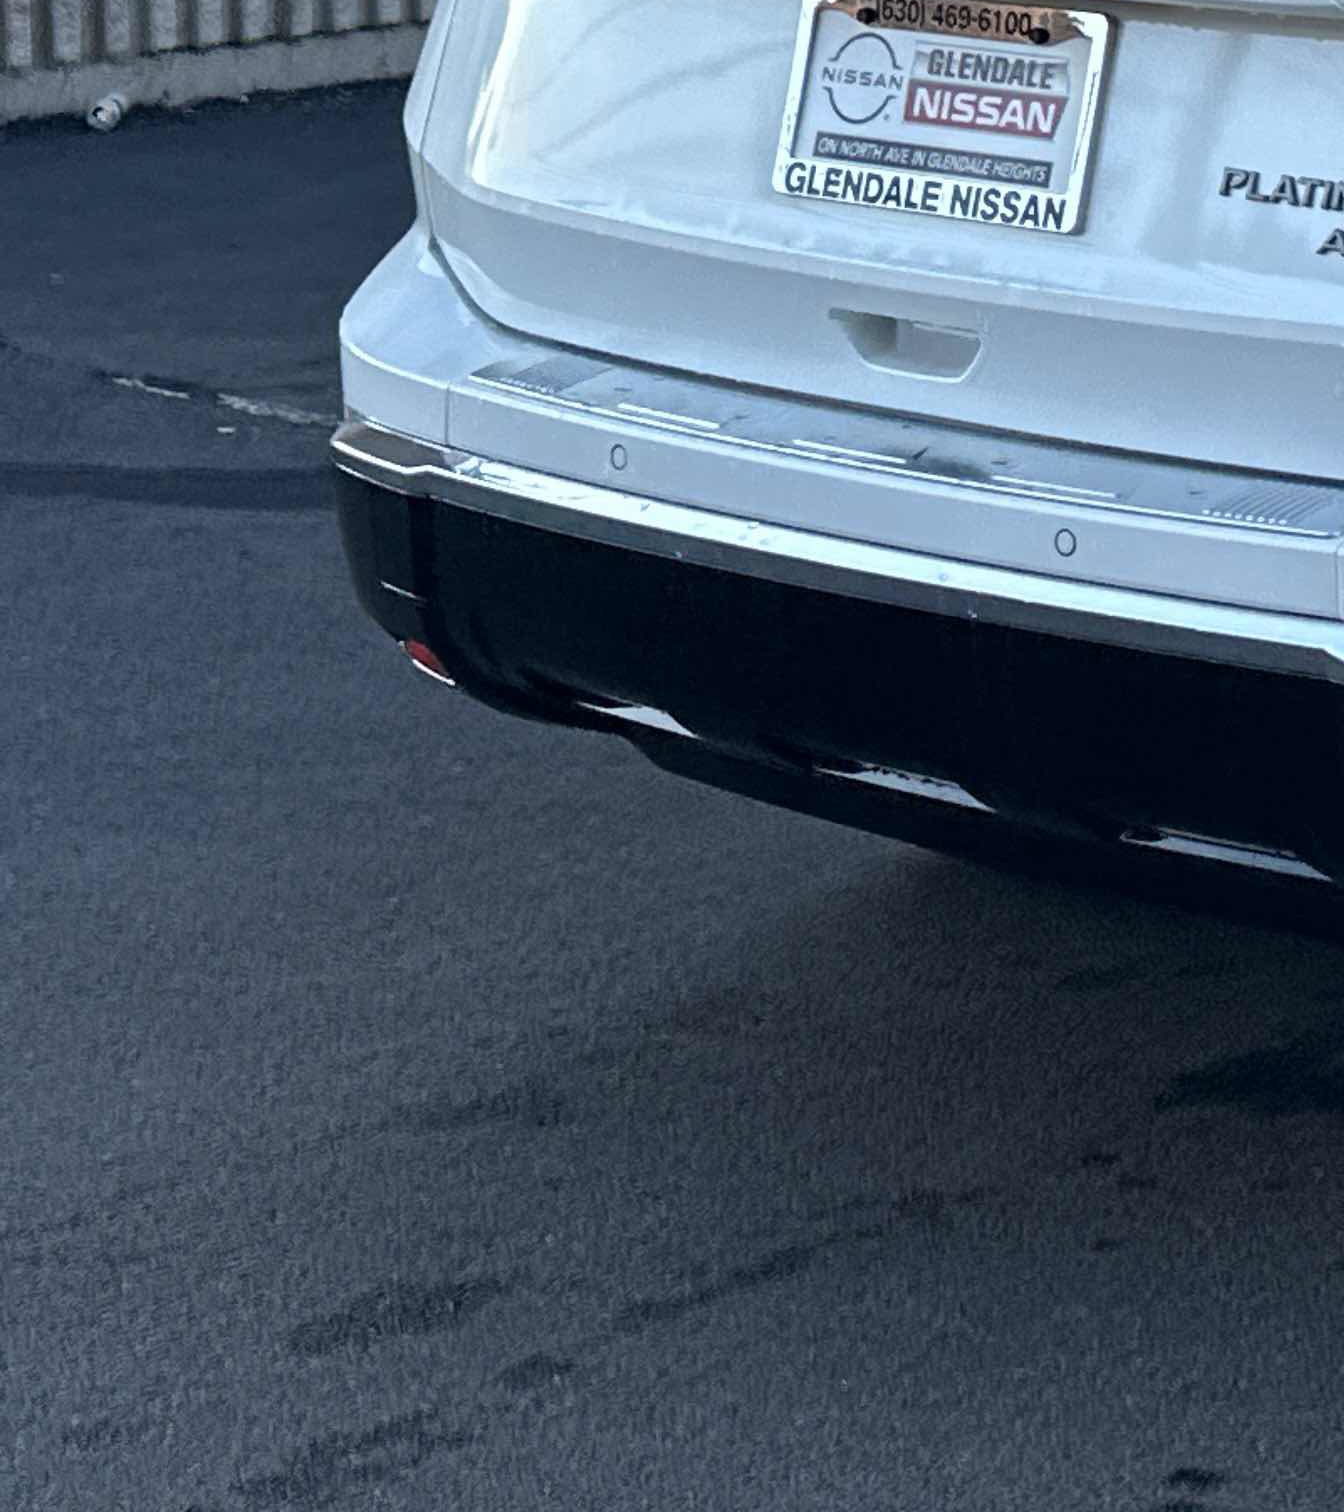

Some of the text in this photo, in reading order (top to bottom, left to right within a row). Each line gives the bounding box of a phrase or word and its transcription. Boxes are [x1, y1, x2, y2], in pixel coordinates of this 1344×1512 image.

[932, 4, 1032, 35] 469-6100
[822, 67, 903, 90] NISSAN
[927, 49, 1055, 89] GLENDALE
[912, 88, 1056, 134] NISSAN
[818, 137, 1048, 184] ON NORTH AVE IN GLENDALE HEIGHTS
[785, 162, 1067, 230] GLENDALE NISSAN
